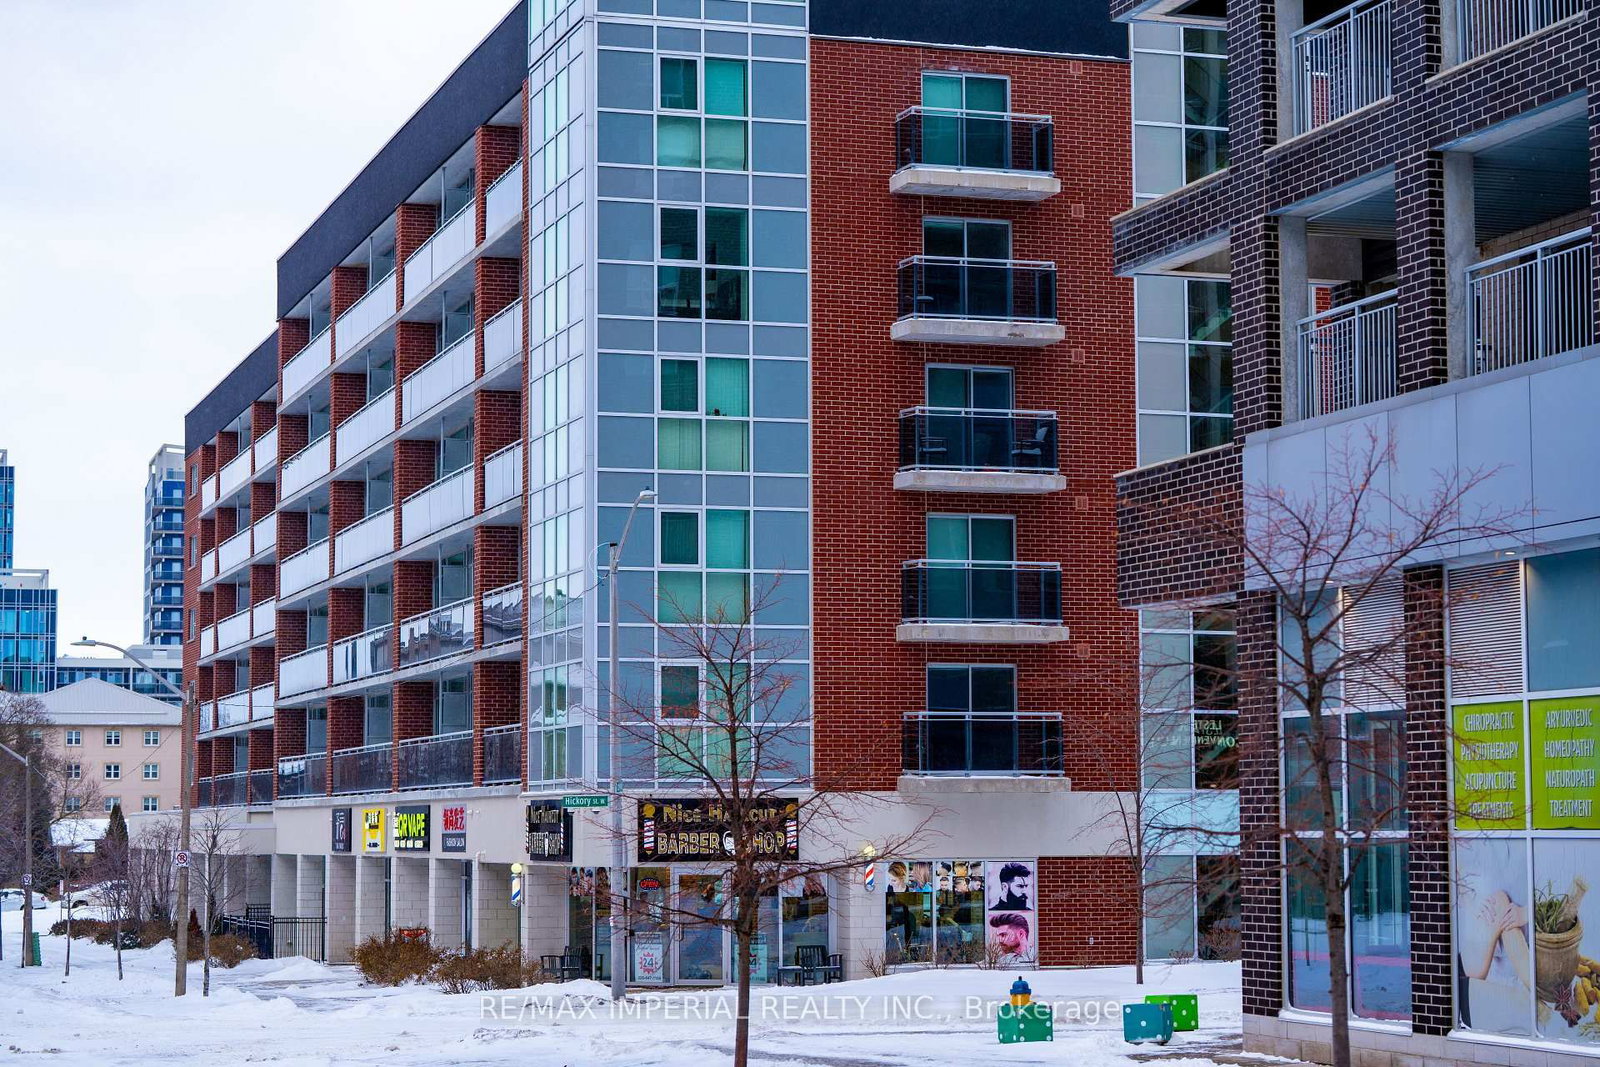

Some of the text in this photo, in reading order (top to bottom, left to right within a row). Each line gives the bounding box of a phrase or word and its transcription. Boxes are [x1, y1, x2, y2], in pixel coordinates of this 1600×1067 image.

[1463, 711, 1515, 732] CHIROPRACTIC
[1460, 741, 1520, 762] PHYSIOTHERAPY
[1544, 738, 1596, 759] HOMEOPATHY
[1464, 771, 1518, 791] ACUPUNCTURE
[1545, 769, 1596, 789] NATUROPATH
[565, 796, 591, 806] Hickory
[1468, 801, 1514, 819] TREATMENTS
[1549, 799, 1593, 817] TREATMENT
[657, 832, 720, 854] BARBER
[640, 880, 659, 888] OPEN
[642, 957, 654, 968] 24
